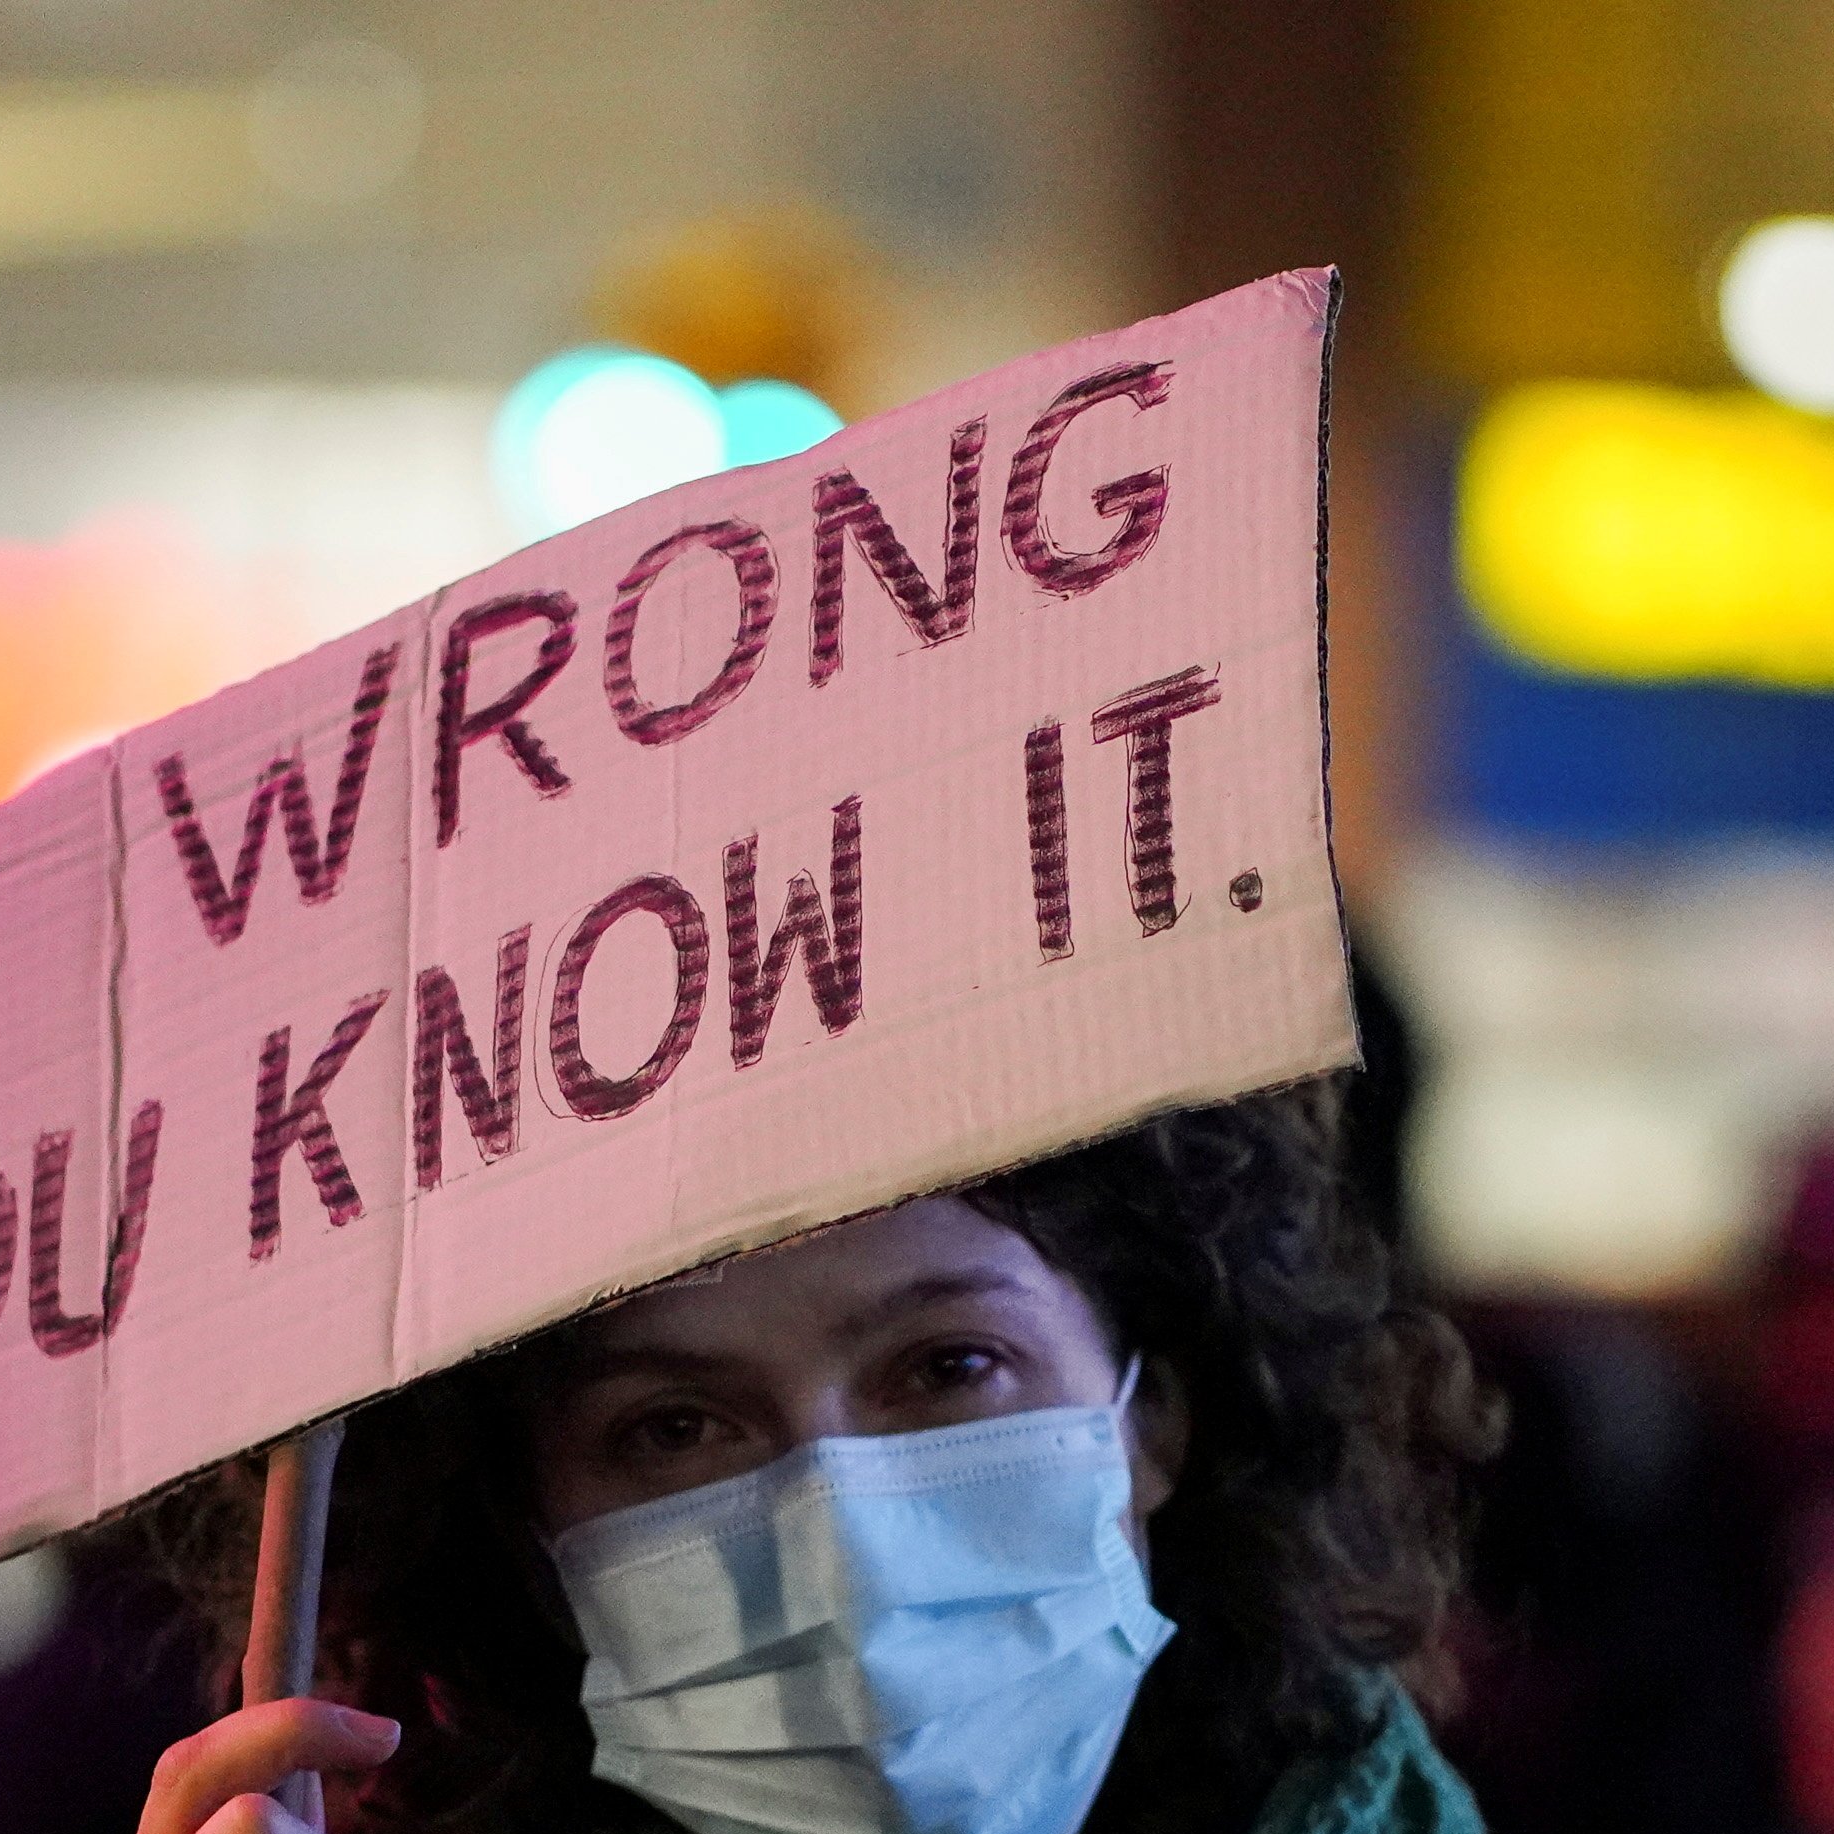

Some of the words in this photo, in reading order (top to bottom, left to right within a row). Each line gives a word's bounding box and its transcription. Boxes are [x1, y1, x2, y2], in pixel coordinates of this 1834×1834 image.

[156, 362, 1173, 945] WRONG
[249, 798, 863, 1257] KNOW
[1026, 666, 1263, 960] IT.
